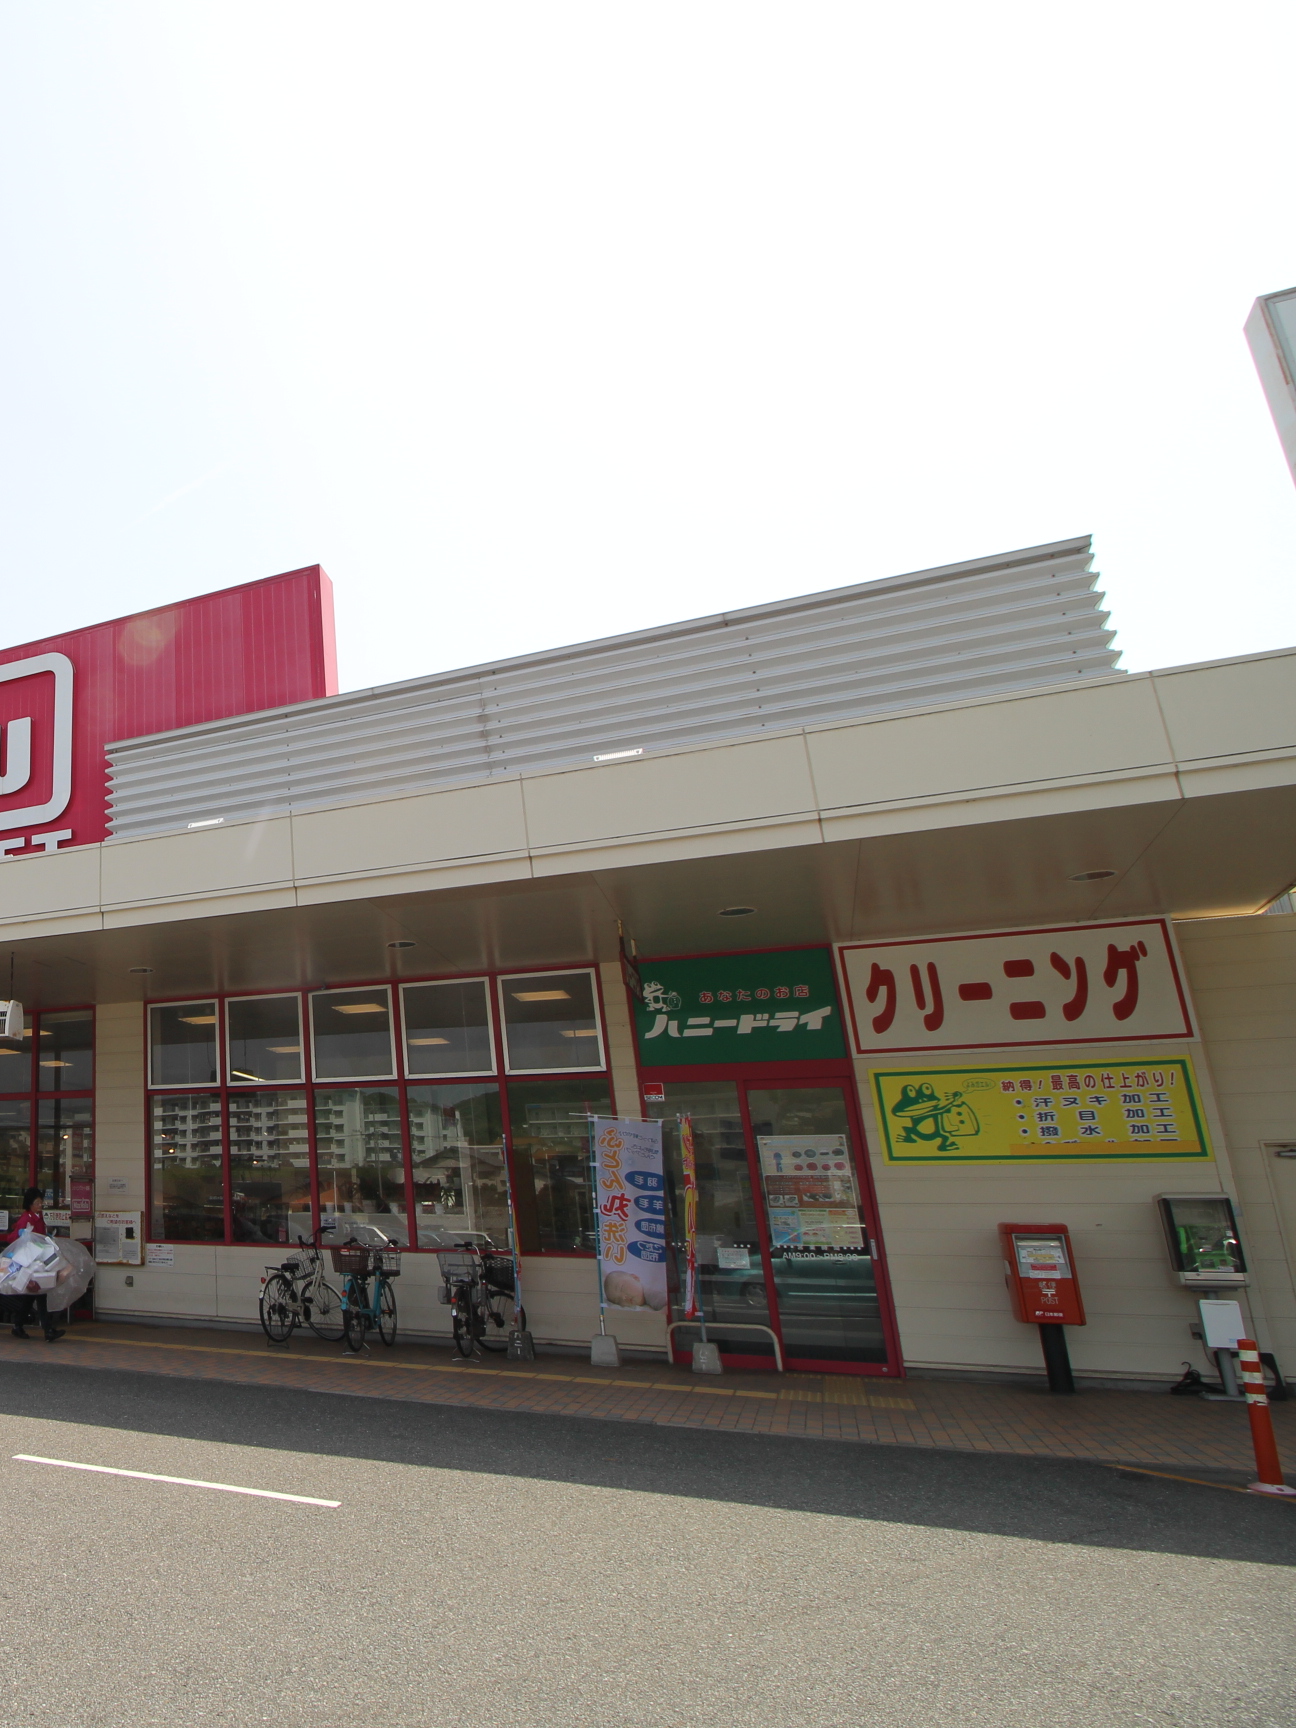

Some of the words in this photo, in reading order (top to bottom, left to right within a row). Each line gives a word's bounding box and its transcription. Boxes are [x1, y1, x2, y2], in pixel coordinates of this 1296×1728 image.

[699, 985, 810, 1003] あなたのお店
[866, 940, 1148, 1034] クリーニング
[644, 1006, 833, 1039] ハニードライ
[1040, 1296, 1059, 1305] POST
